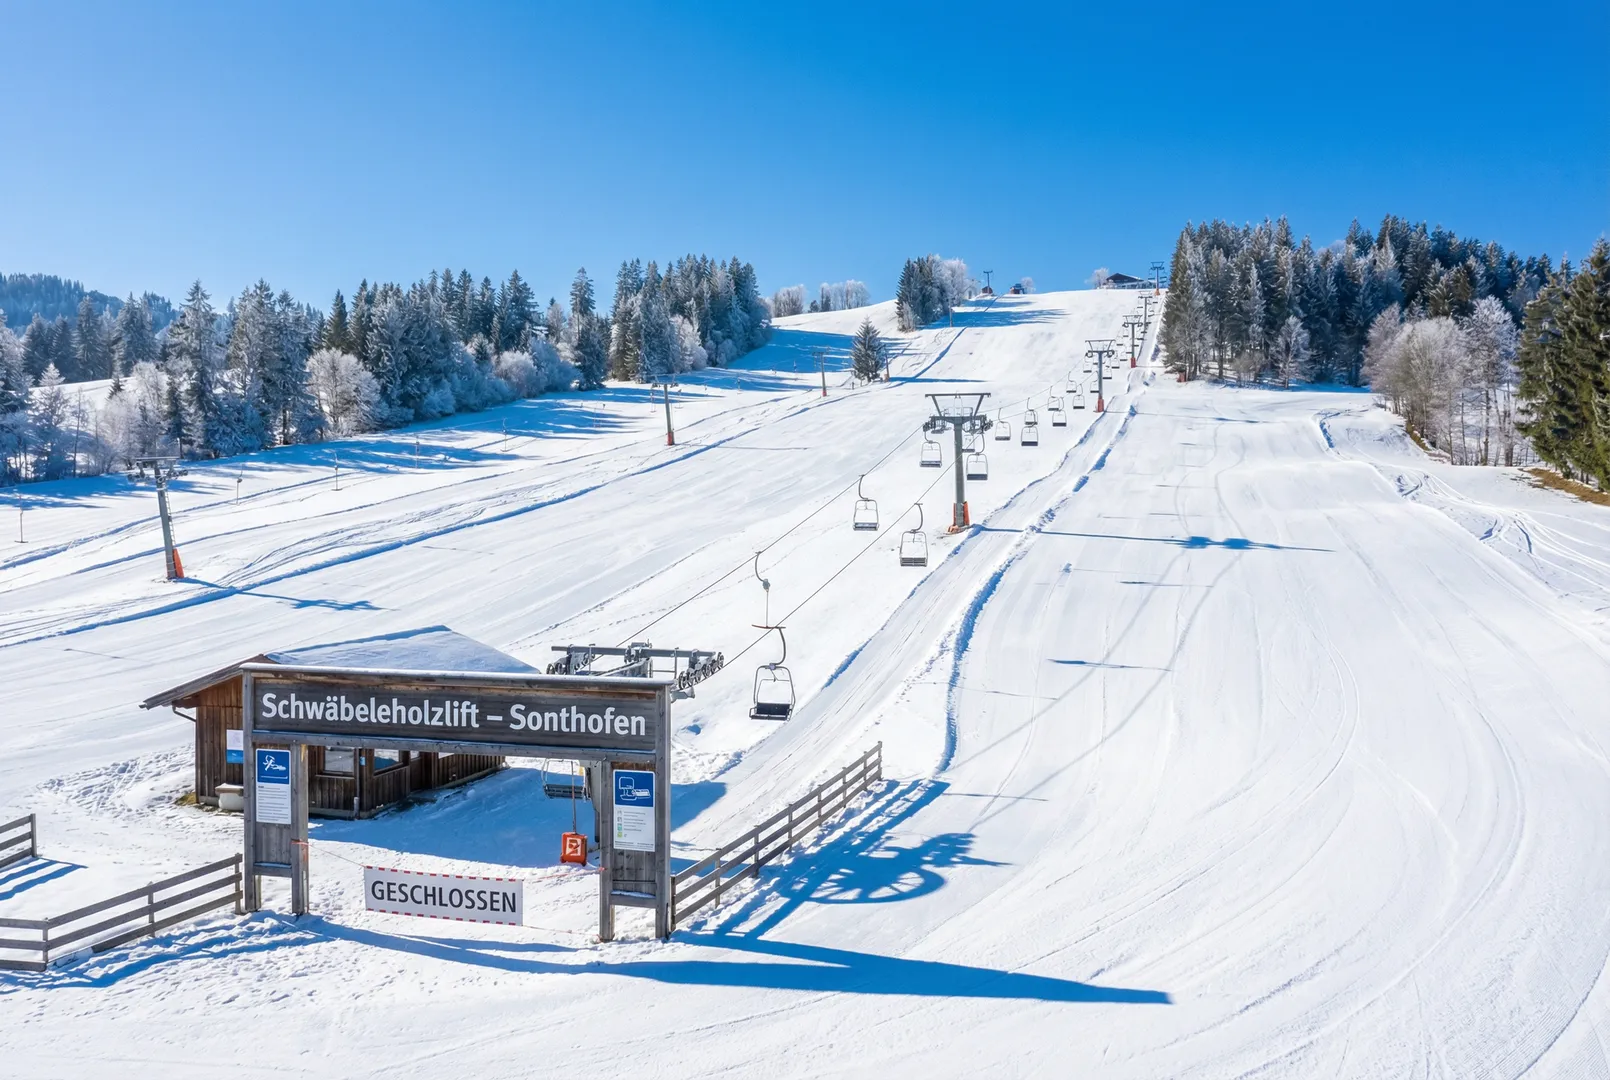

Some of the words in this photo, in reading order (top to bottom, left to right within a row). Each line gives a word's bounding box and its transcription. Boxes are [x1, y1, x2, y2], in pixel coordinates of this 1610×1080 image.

[261, 692, 480, 729] Schwäbeleholzlift
[509, 703, 646, 736] Sonthofen
[371, 880, 516, 913] GESCHLOSSEN
